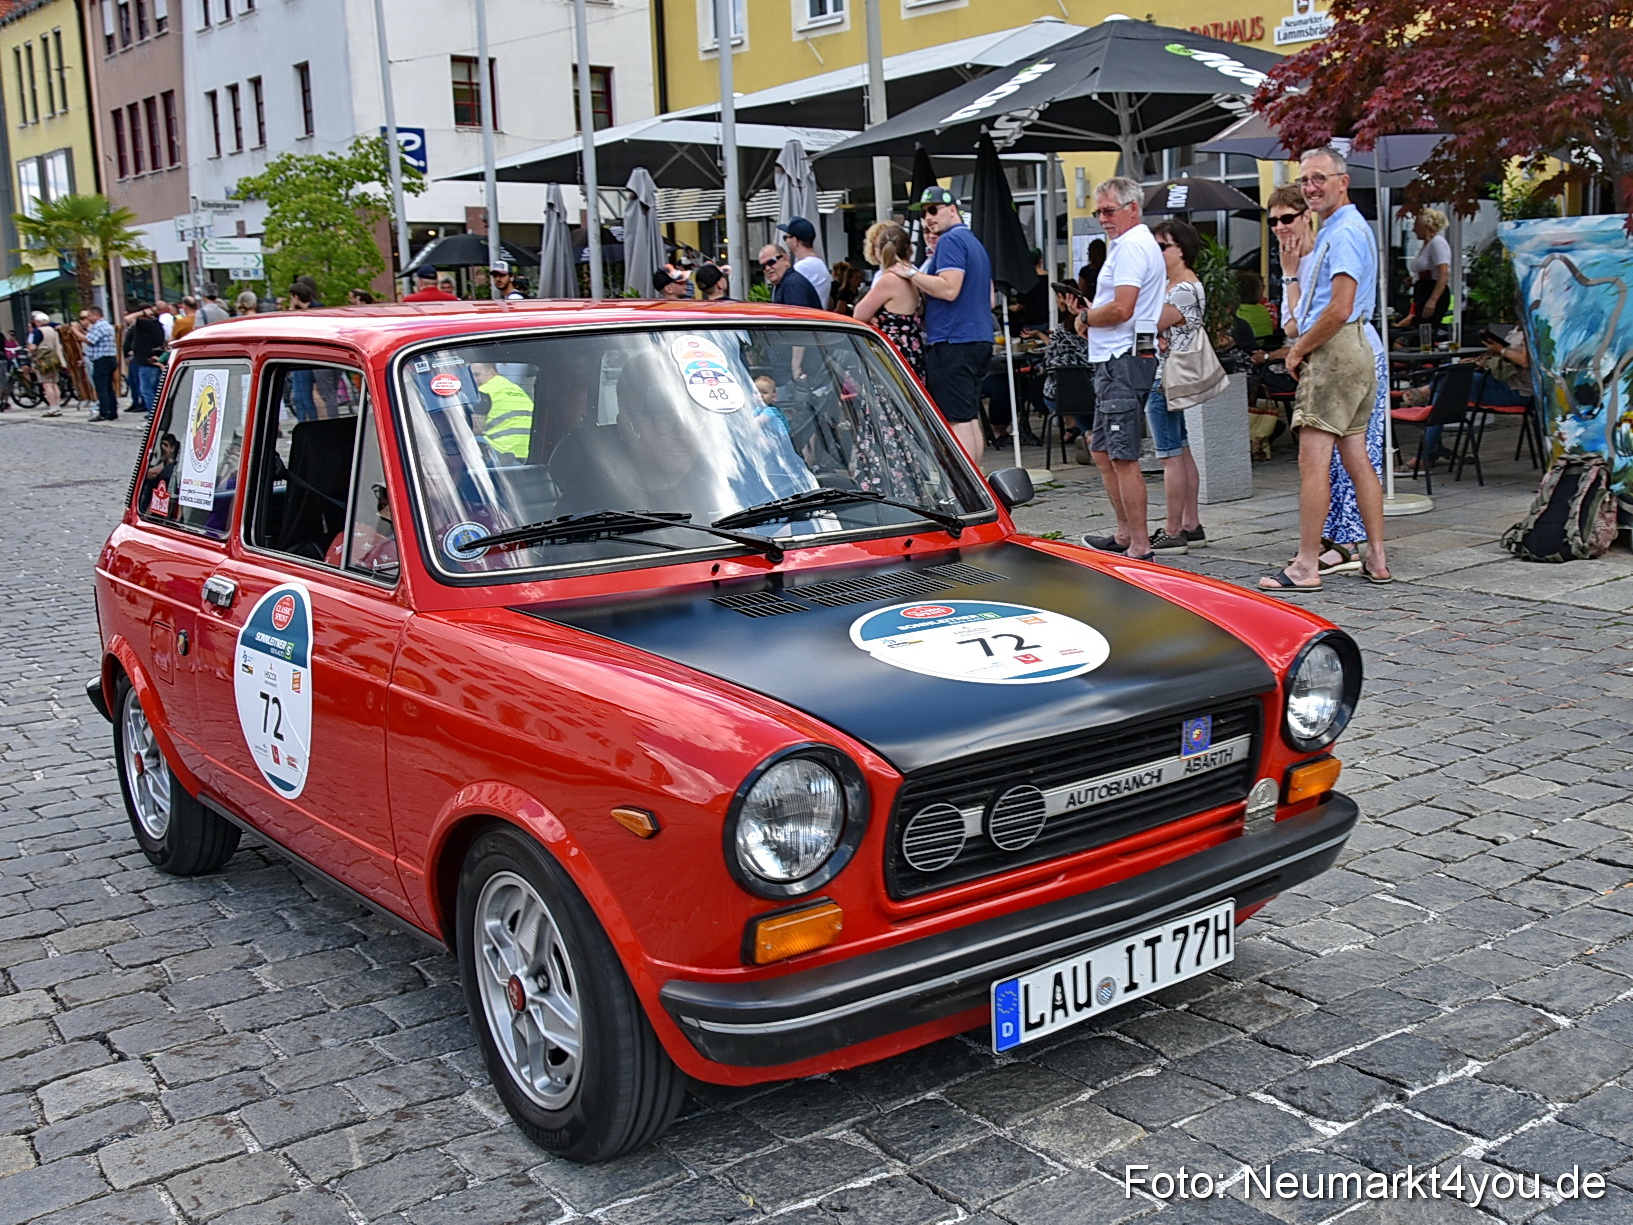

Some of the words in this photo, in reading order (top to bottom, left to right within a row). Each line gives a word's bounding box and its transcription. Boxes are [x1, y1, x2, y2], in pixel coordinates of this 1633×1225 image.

[1284, 16, 1323, 27] Neumarkter
[709, 388, 729, 400] 48
[956, 633, 1042, 657] 72
[259, 690, 285, 742] 72
[1183, 746, 1235, 776] ABARTH
[1022, 960, 1093, 1032] LAU
[1001, 1021, 1014, 1038] D
